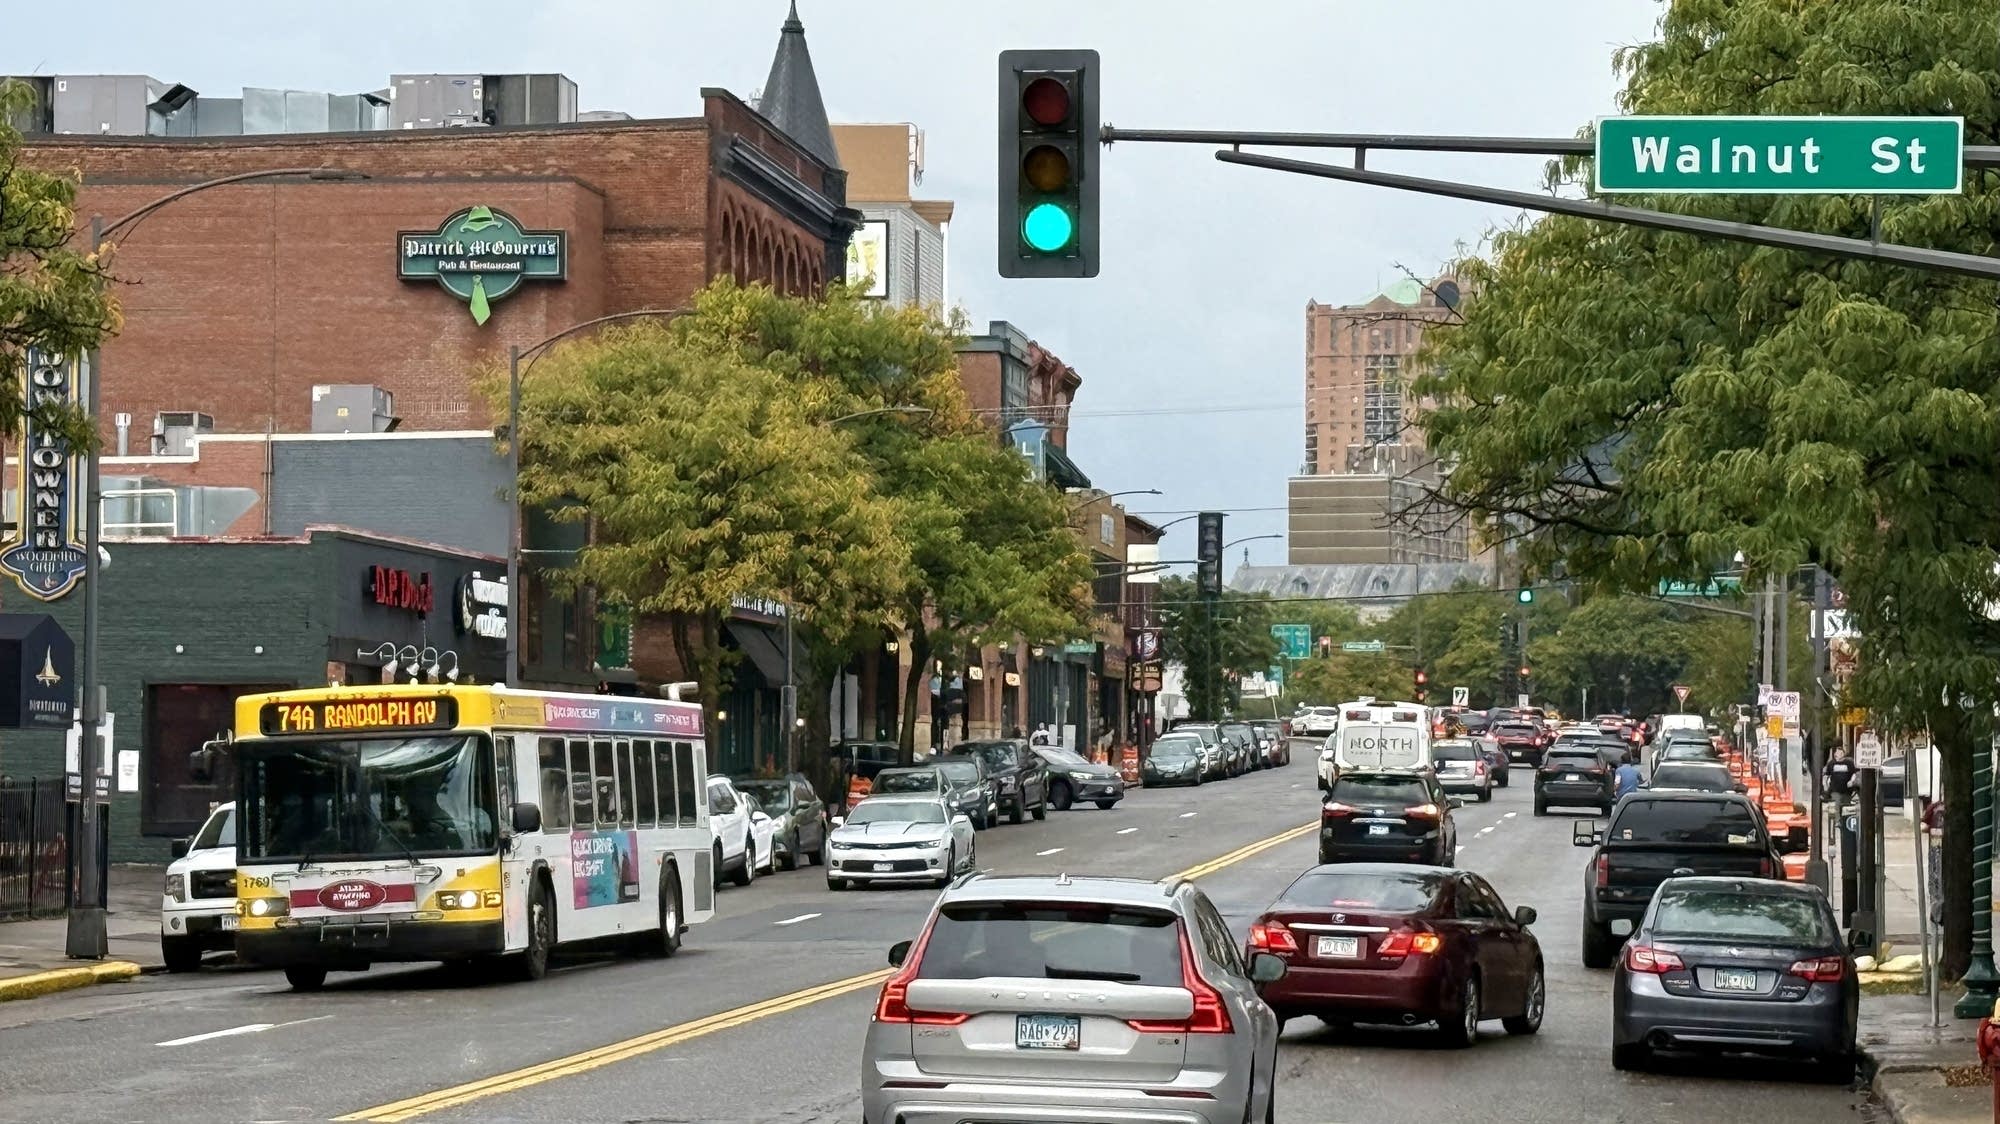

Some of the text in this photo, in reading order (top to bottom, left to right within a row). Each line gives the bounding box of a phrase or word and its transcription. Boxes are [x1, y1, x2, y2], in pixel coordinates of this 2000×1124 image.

[1632, 136, 1927, 174] Walnut St
[406, 240, 557, 258] Patrick McGovern's
[438, 260, 521, 270] Pub & Restaurant
[278, 700, 436, 732] 74A RANDOLPH AV
[1350, 737, 1412, 749] NORTH
[244, 877, 270, 888] 1769
